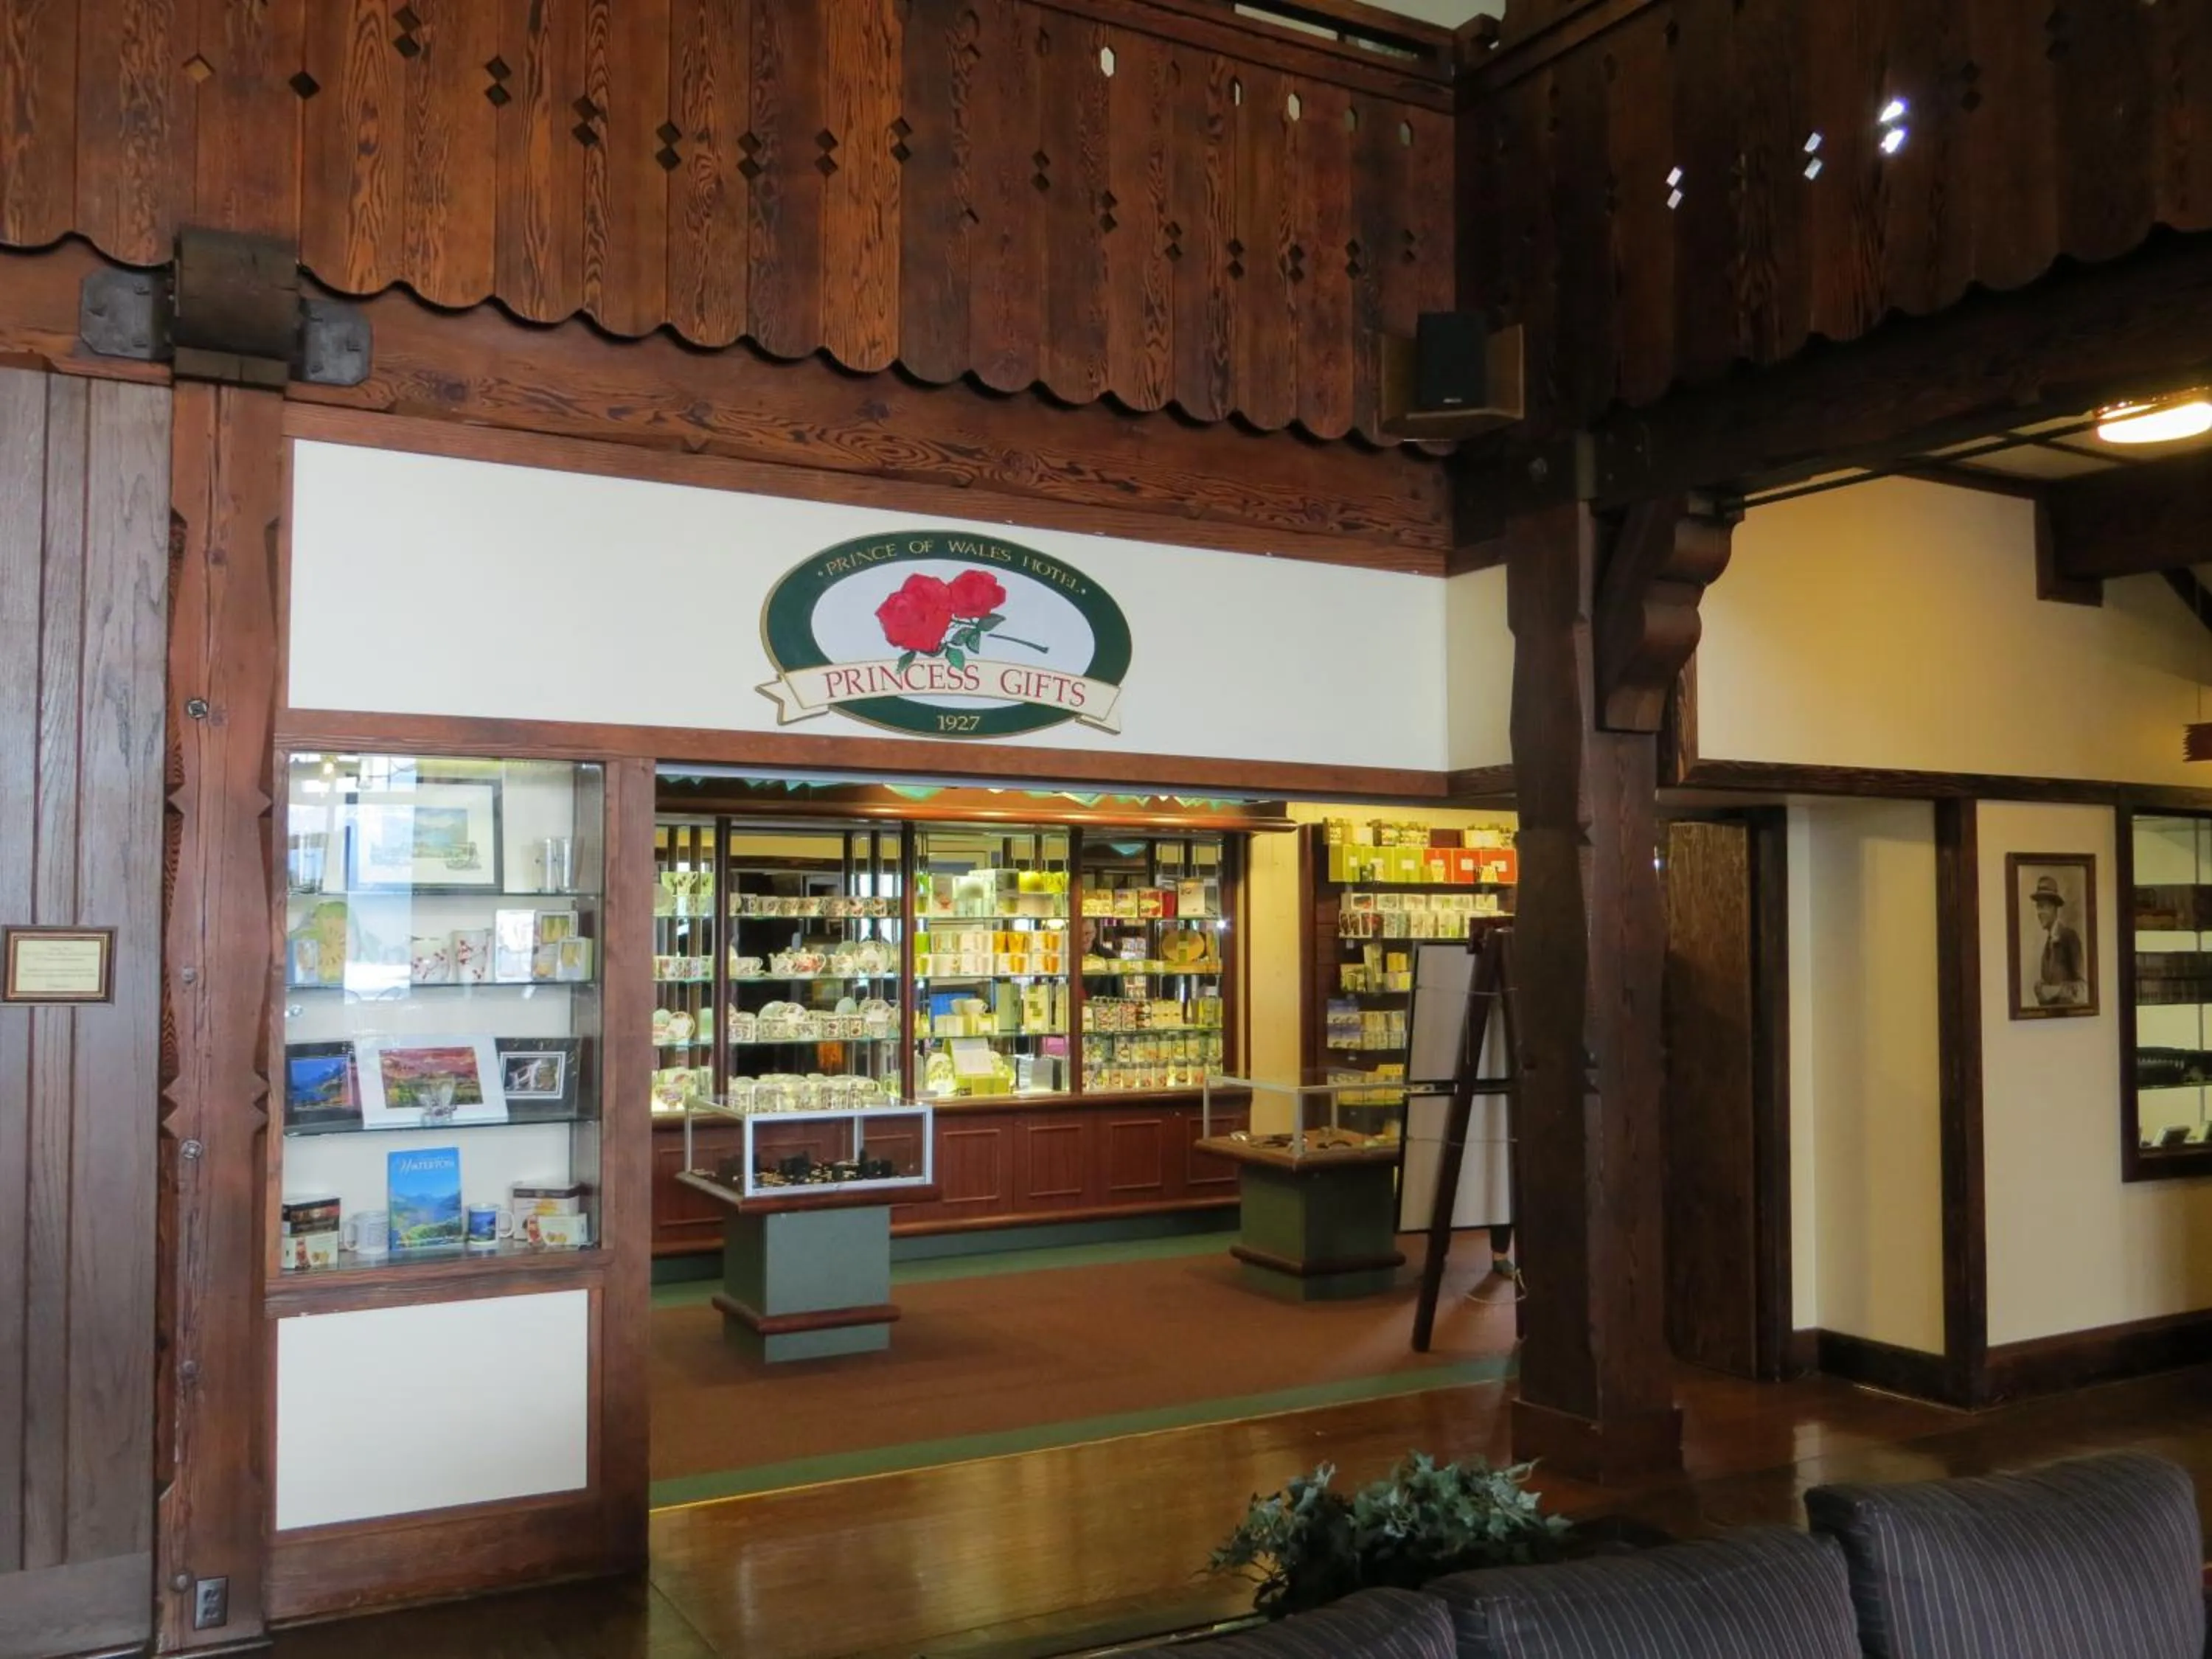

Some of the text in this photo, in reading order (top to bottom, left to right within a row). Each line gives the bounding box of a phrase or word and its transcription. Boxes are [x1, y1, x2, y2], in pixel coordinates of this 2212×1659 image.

[826, 540, 1080, 593] PRINCE OF WALES HOTEL
[824, 664, 1086, 707] PRINCESS GIFTS
[937, 714, 981, 731] 1927
